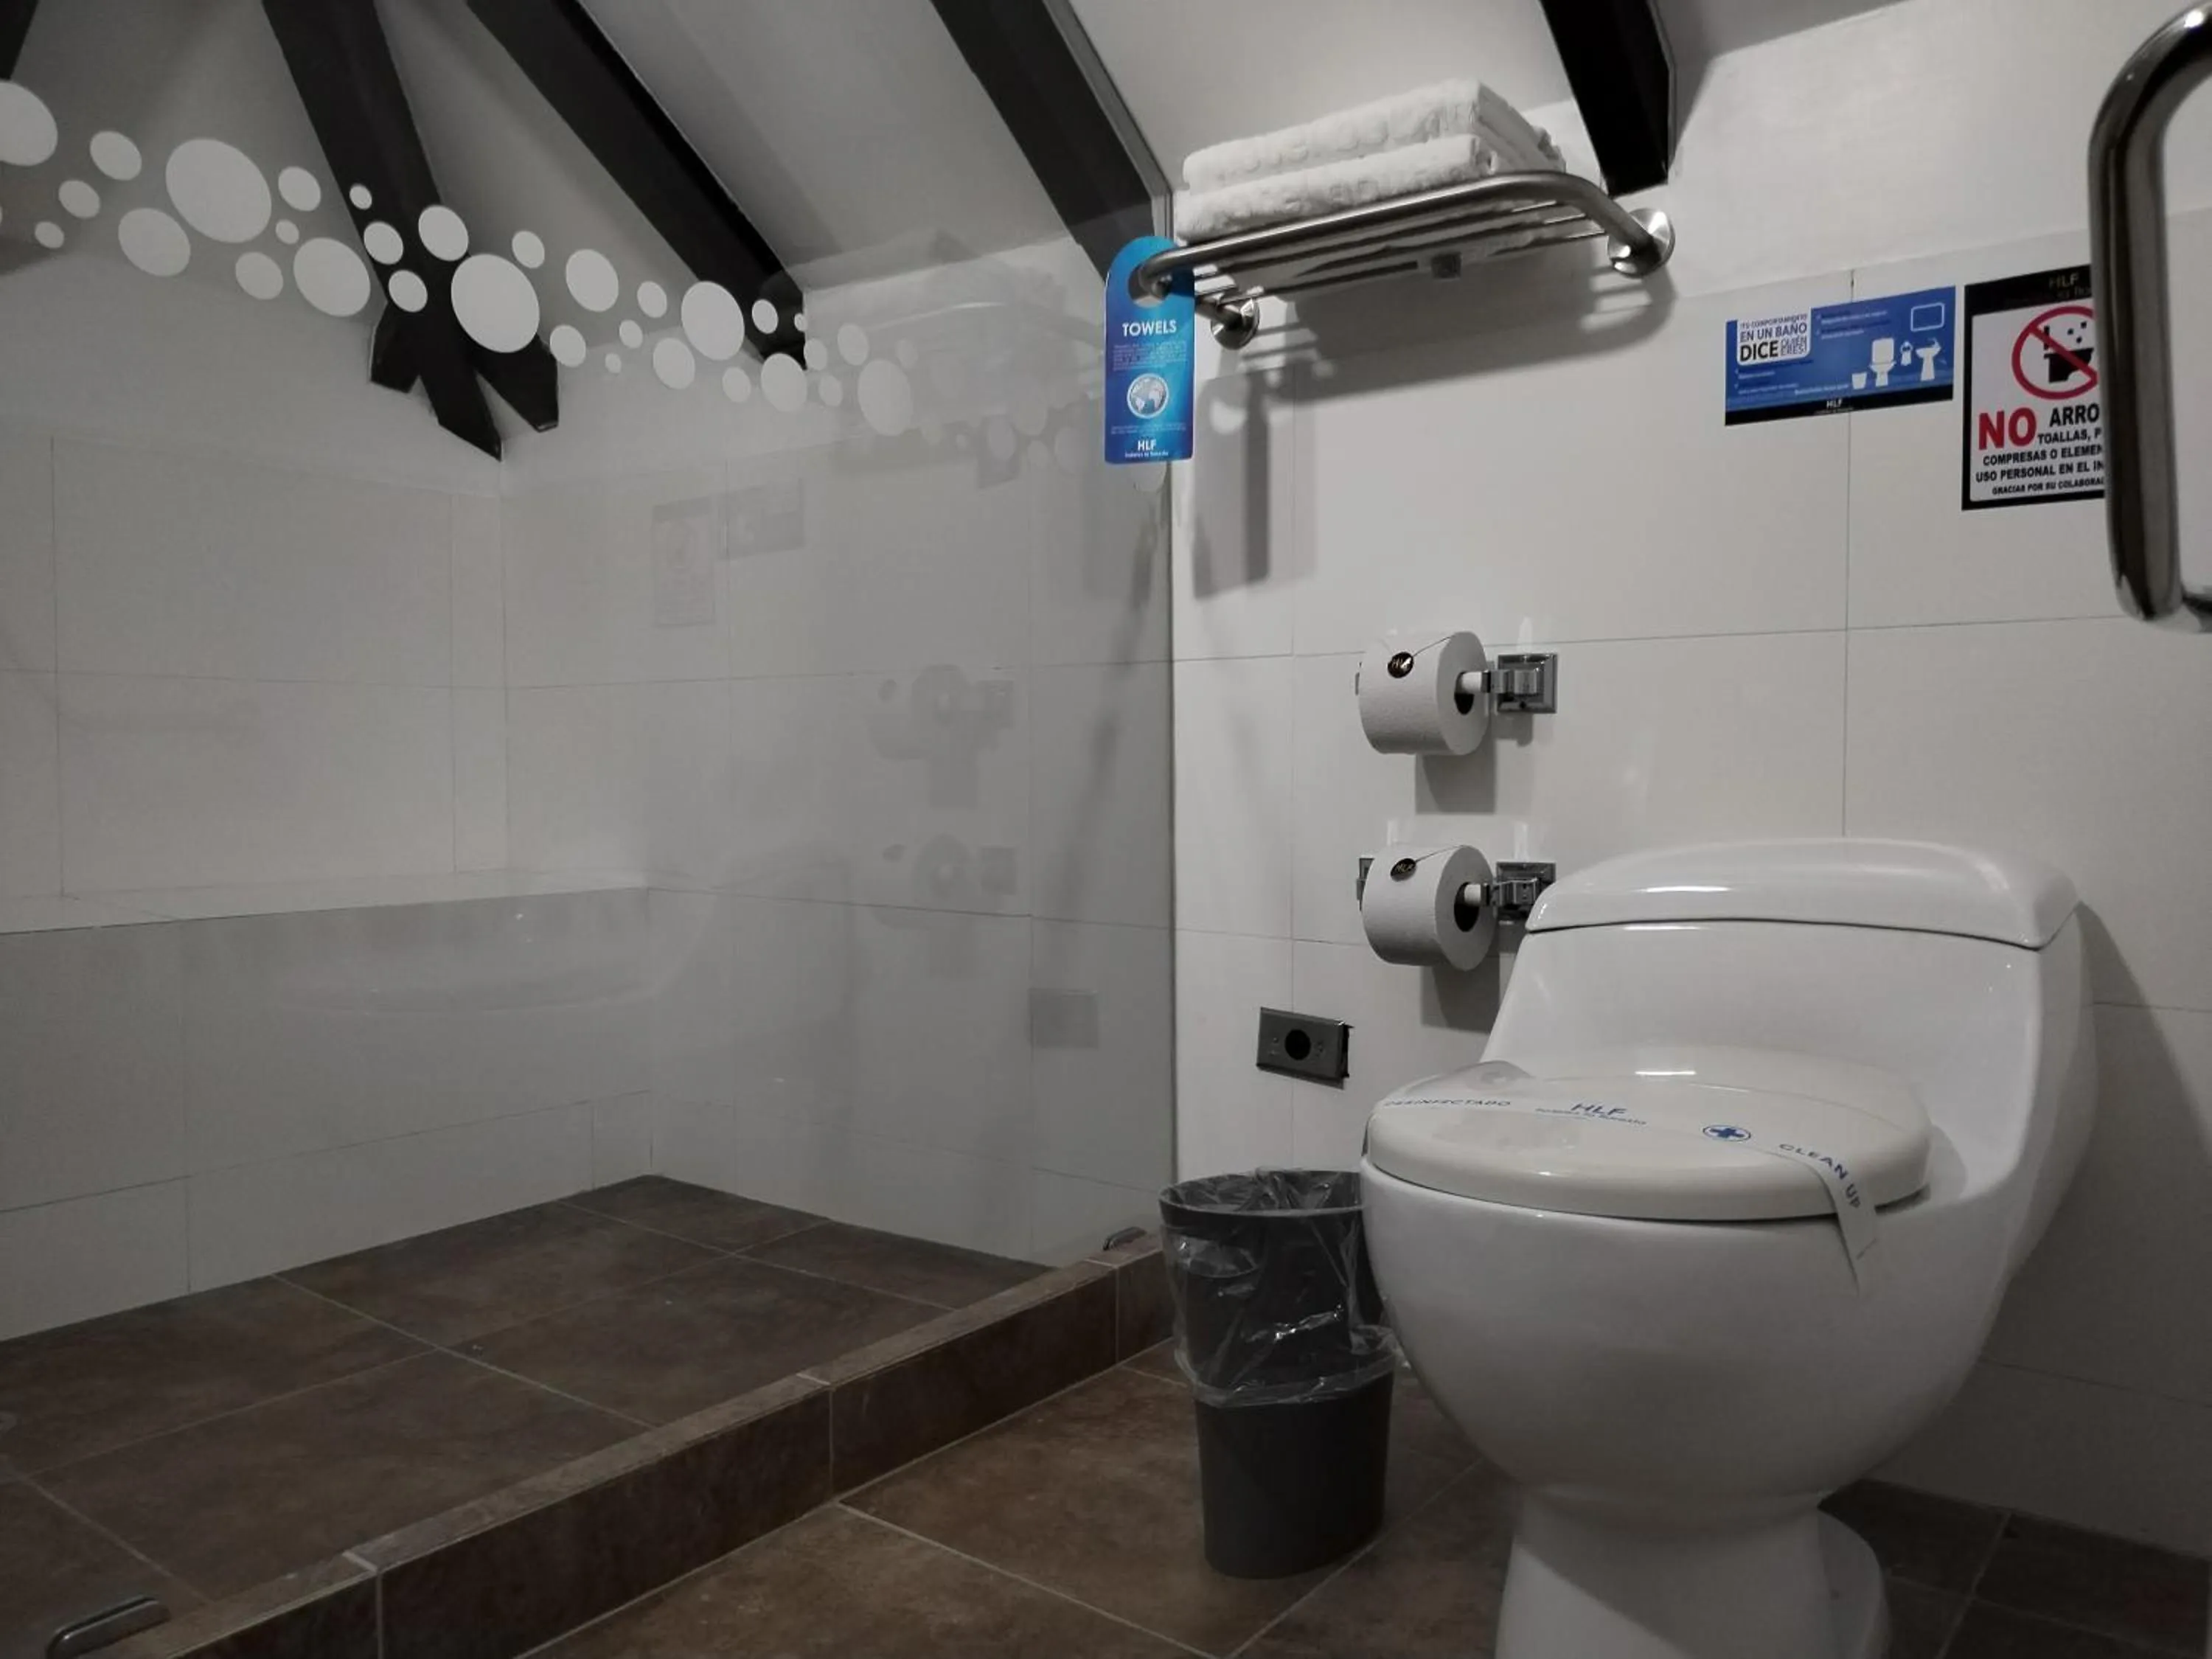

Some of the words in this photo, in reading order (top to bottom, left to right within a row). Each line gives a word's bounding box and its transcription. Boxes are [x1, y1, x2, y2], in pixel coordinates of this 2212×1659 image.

[1122, 319, 1177, 337] TOWELS
[1741, 330, 1754, 342] EN
[1758, 327, 1773, 339] UN
[1741, 340, 1778, 361] DICE
[1978, 407, 2037, 451] NO
[2037, 428, 2090, 445] TOALLAS,
[1138, 439, 1156, 451] HLF
[1983, 450, 2047, 466] COMPRESAS
[2050, 449, 2058, 459] O
[1975, 470, 1997, 482] USO
[2000, 466, 2056, 481] PERSONAL
[2059, 462, 2073, 474] EN
[2077, 462, 2090, 473] EL
[1992, 484, 2025, 495] GRACIAS
[2028, 482, 2043, 493] POR
[2045, 481, 2056, 490] SU
[1571, 1104, 1627, 1115] HLF
[1778, 1144, 1848, 1180] CLEAN
[1845, 1183, 1861, 1208] UP
